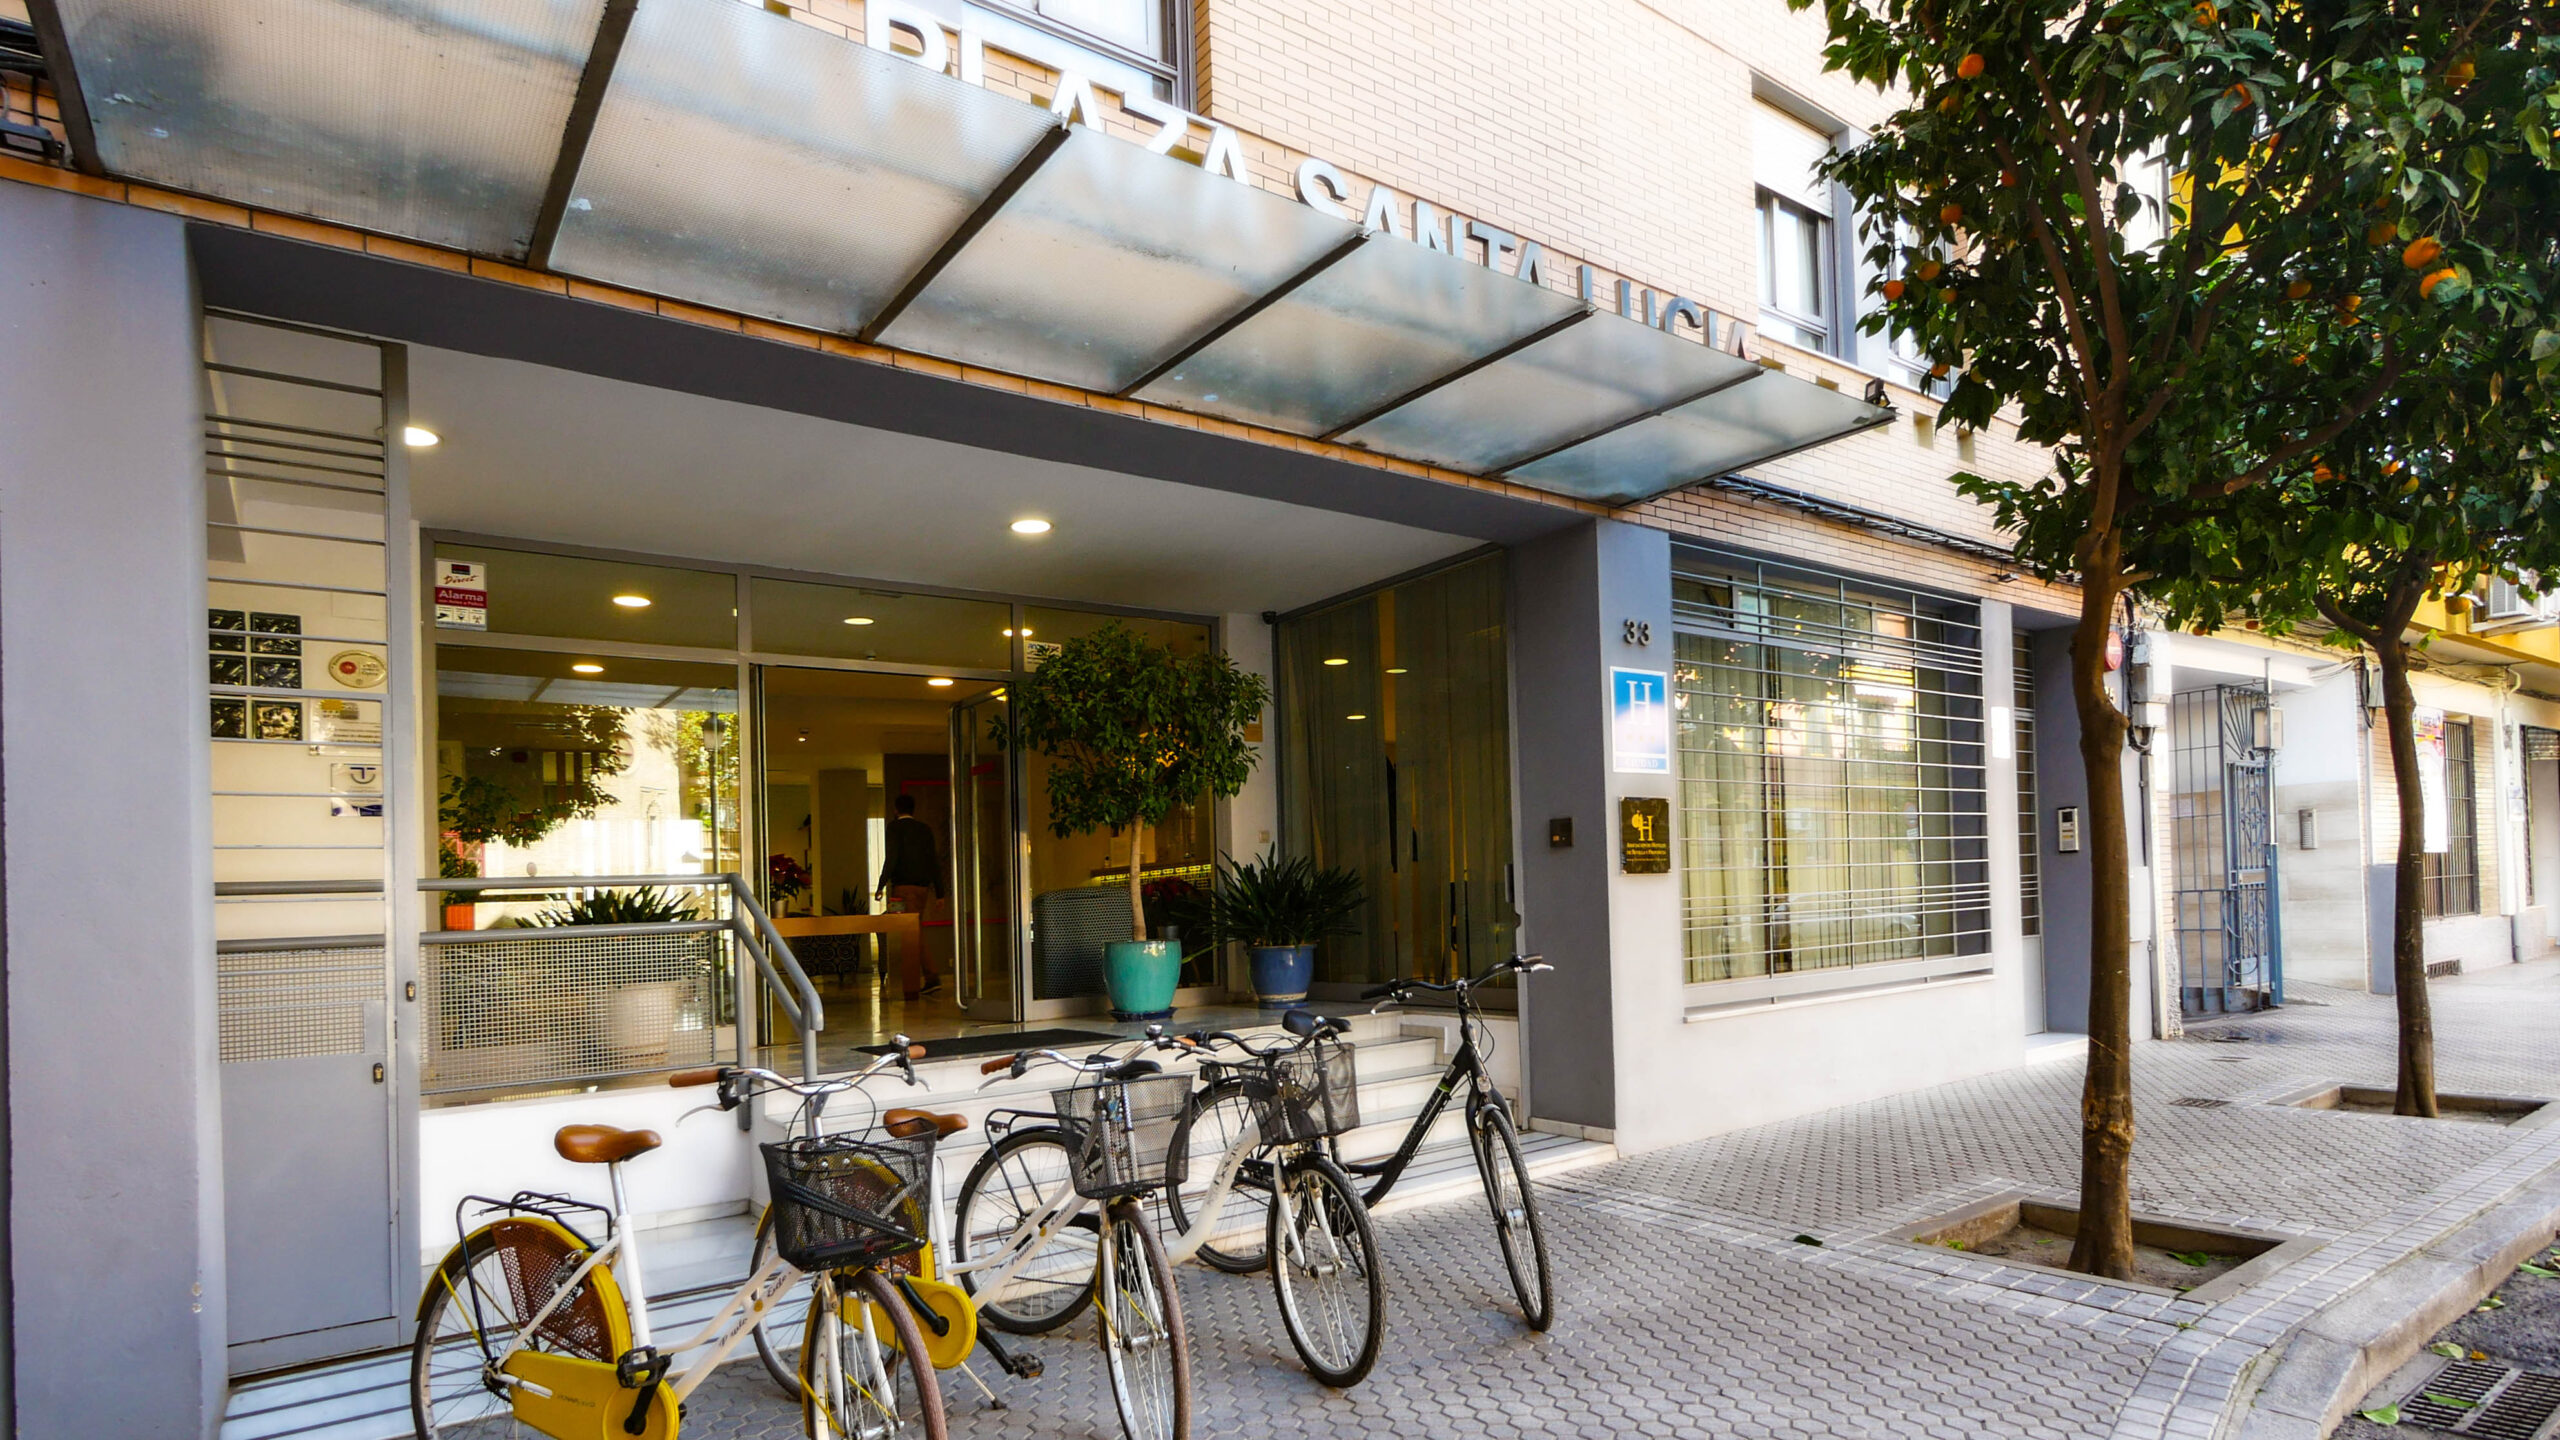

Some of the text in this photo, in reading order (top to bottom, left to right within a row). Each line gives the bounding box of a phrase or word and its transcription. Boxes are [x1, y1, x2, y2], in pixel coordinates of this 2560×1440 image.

[1294, 158, 1549, 288] SANTA
[438, 589, 484, 602] Alarma
[1624, 618, 1652, 646] 33
[1626, 680, 1653, 727] H
